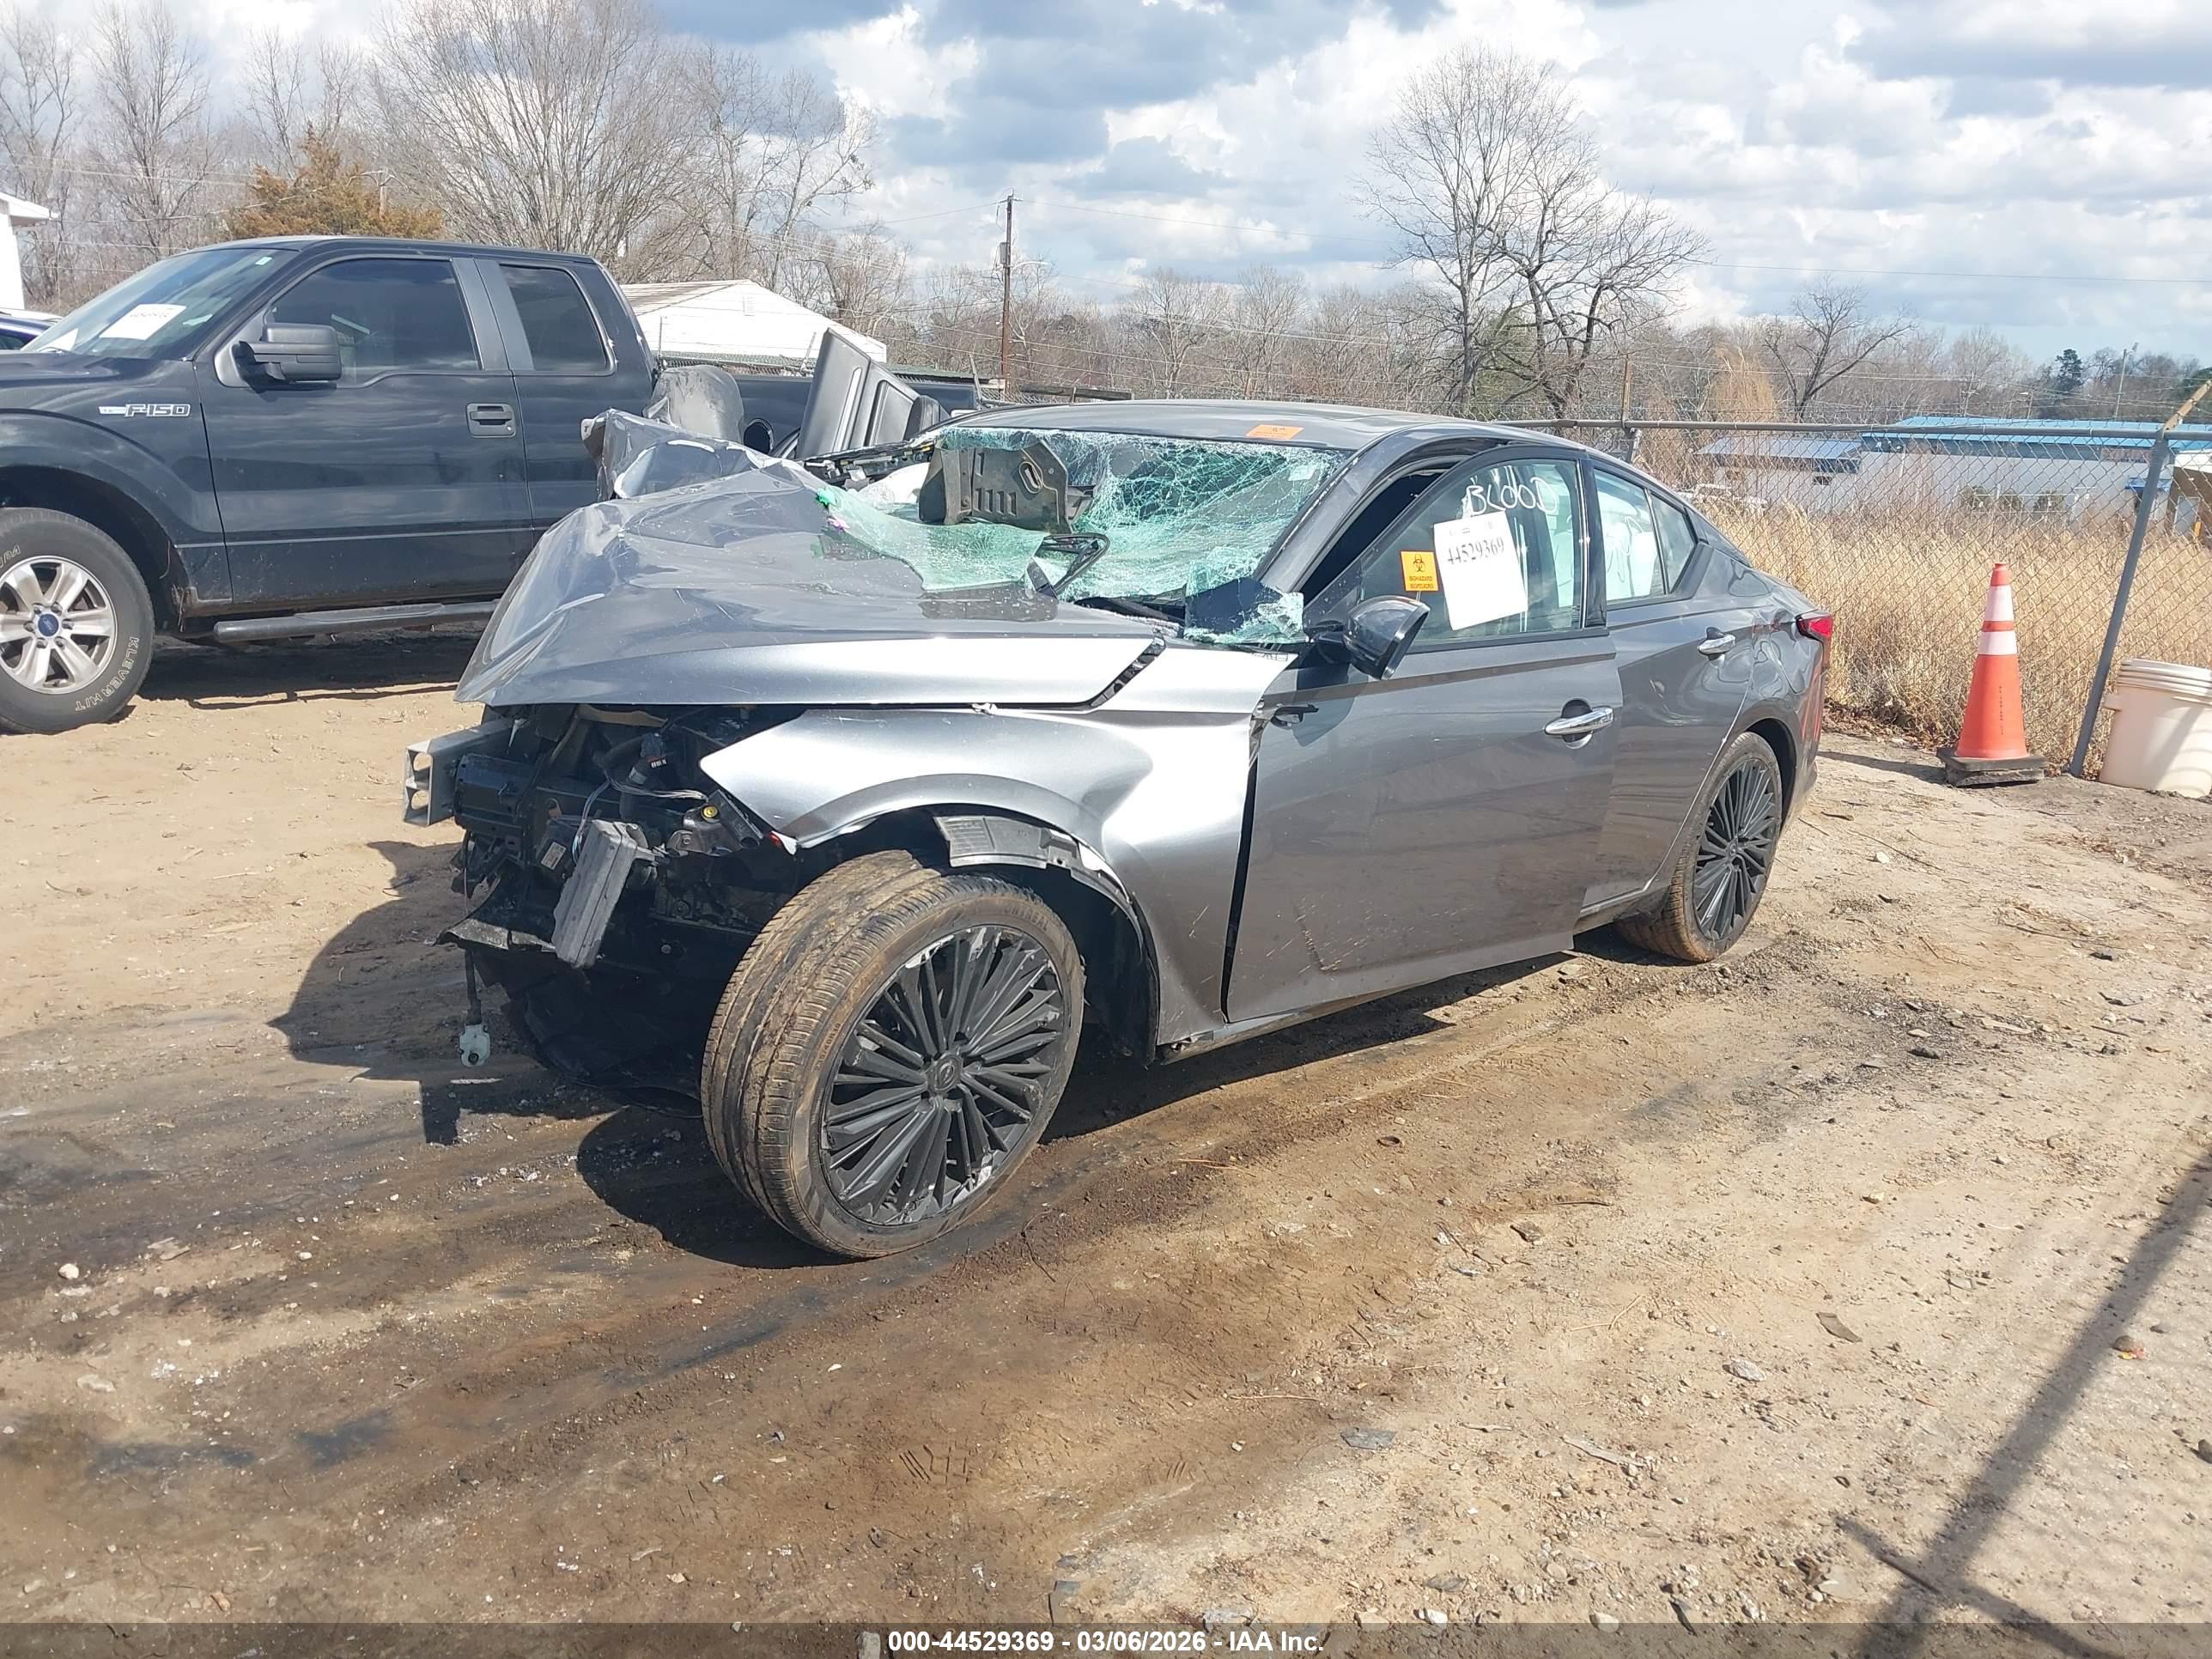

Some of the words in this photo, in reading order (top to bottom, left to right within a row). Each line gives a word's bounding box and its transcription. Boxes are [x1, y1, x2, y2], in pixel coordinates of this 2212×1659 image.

[1465, 477, 1558, 515] BLOOD
[1447, 538, 1504, 565] 44529369
[100, 636, 139, 697] KLEVER
